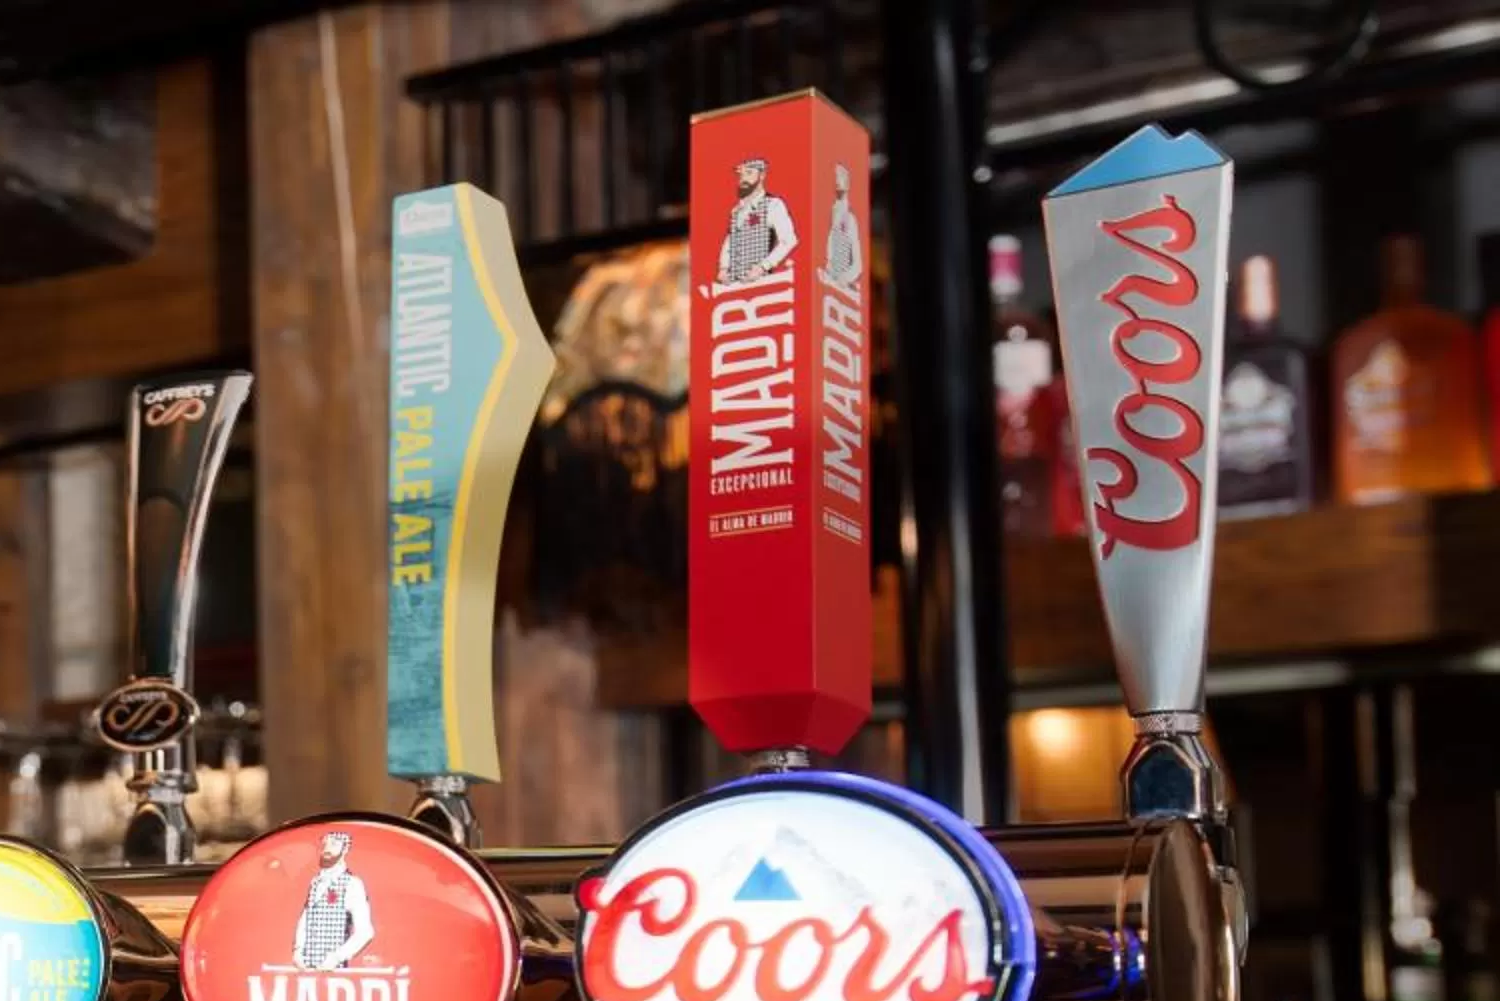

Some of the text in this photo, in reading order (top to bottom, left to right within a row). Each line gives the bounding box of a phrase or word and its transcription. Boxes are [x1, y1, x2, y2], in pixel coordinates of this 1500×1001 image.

[396, 253, 453, 397] ATLANTIC
[1085, 193, 1206, 561] Coors
[391, 405, 434, 586] PALE ALE
[710, 467, 795, 496] EXCEPCIONAL
[27, 958, 80, 987] PALE
